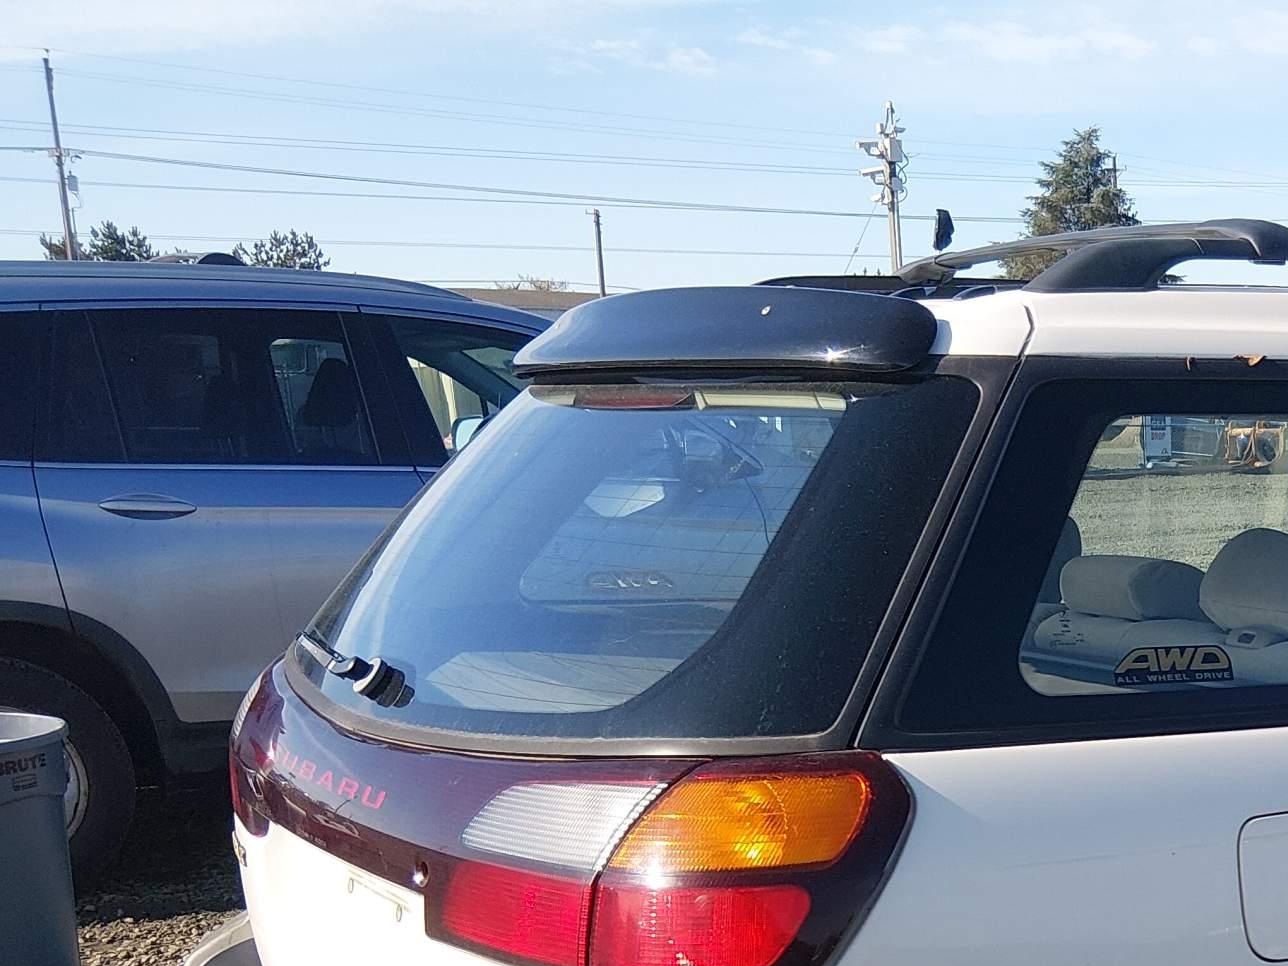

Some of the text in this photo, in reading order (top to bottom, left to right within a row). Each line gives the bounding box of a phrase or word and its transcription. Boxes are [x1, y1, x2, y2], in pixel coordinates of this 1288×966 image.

[1116, 648, 1229, 673] AWD
[1147, 673, 1190, 682] WHEEL
[1195, 671, 1231, 680] DRIVE
